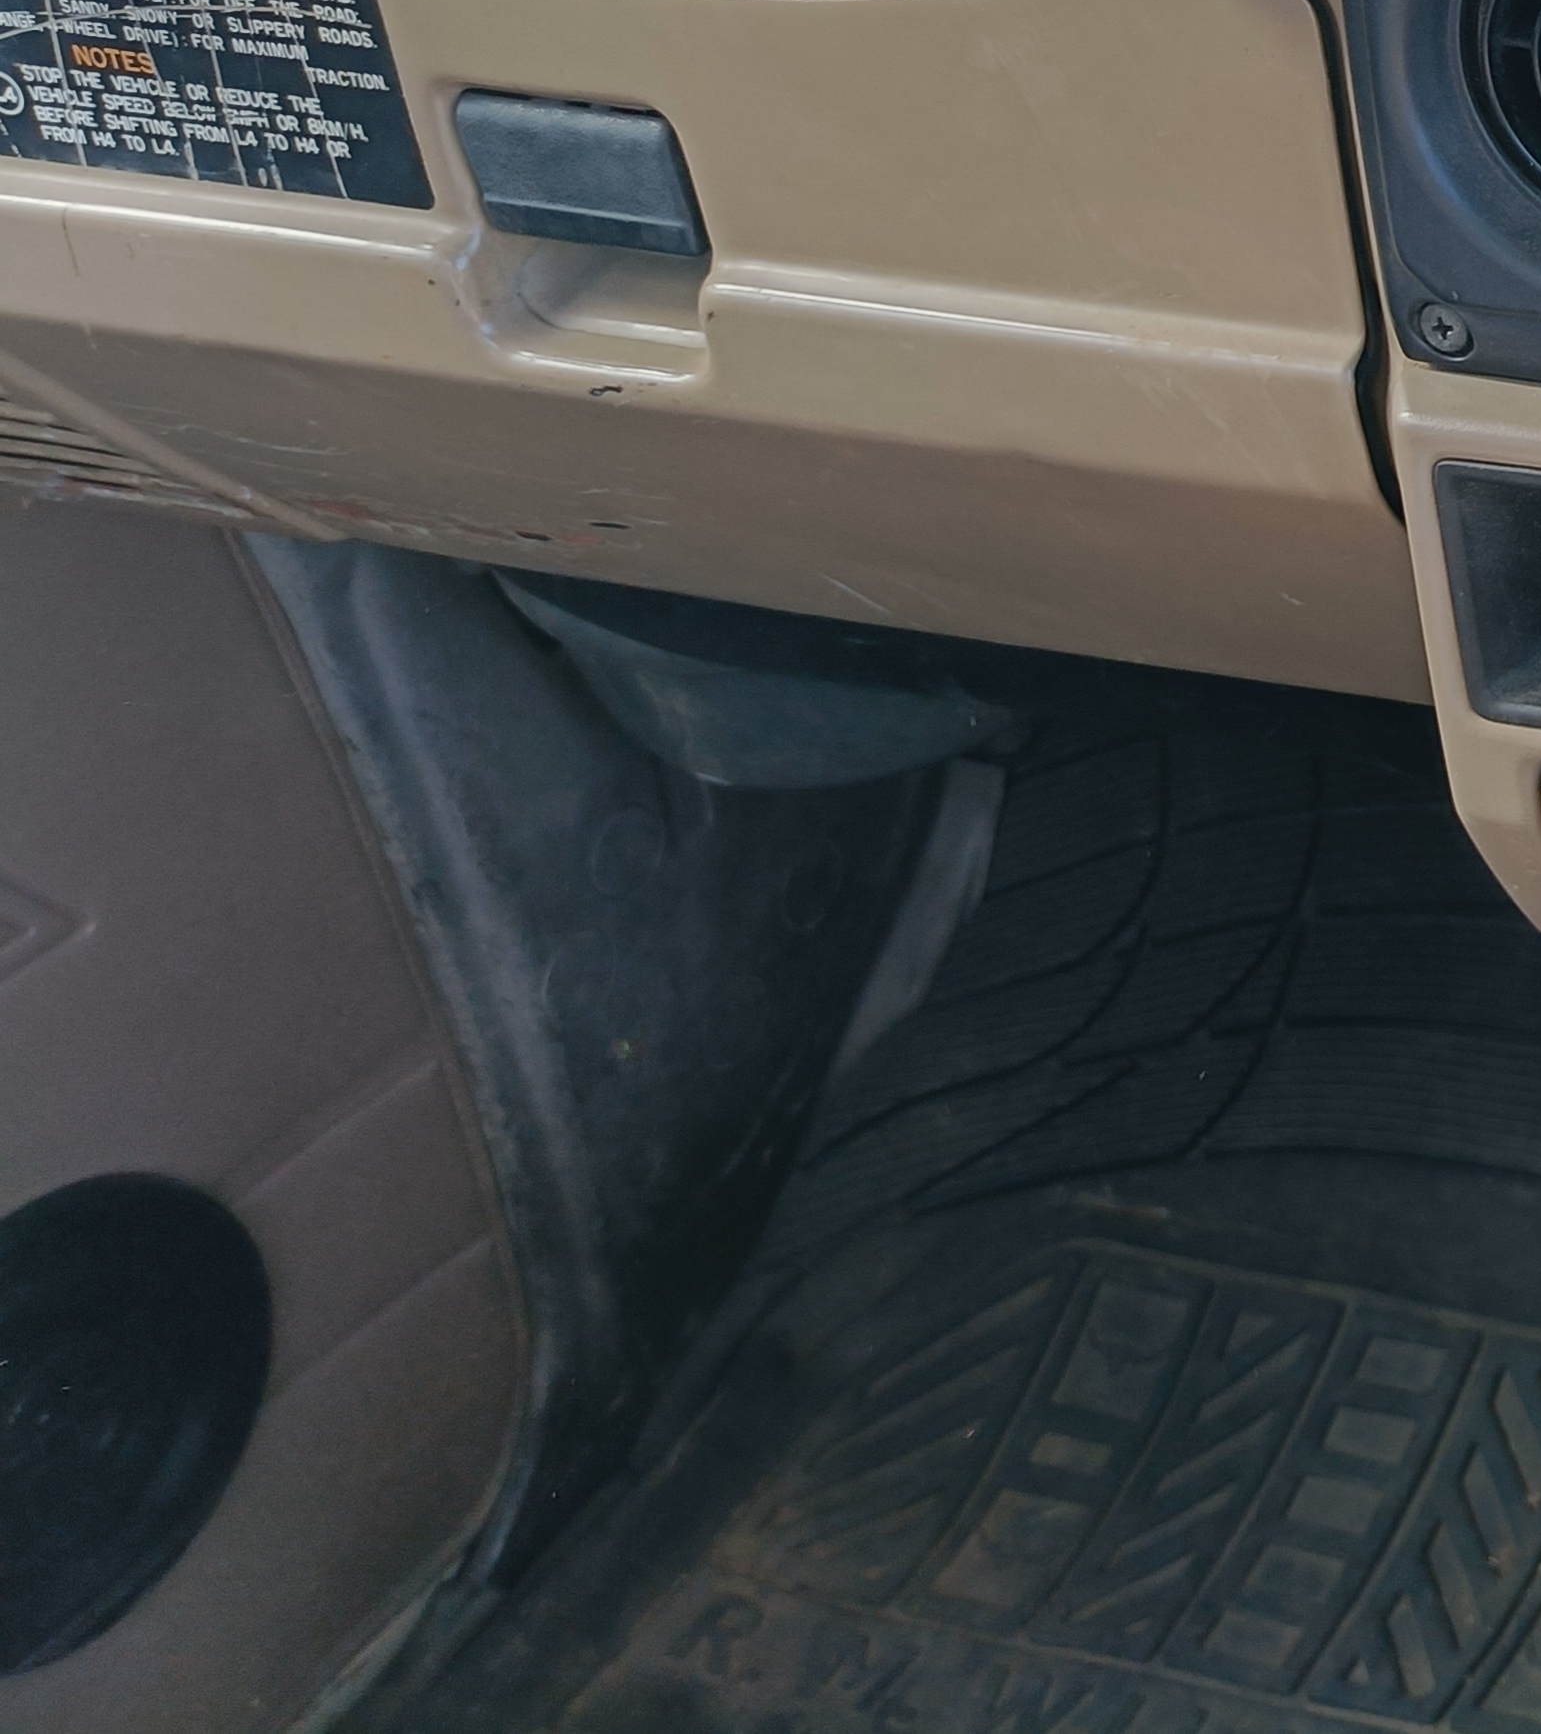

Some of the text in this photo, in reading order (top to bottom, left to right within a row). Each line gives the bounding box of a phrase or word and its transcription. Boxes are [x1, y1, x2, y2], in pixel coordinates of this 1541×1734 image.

[192, 13, 215, 31] OR
[226, 16, 305, 40] SLIPPERY
[71, 44, 155, 75] NOTES
[190, 32, 226, 53] FOR
[231, 38, 309, 62] MAXIMUM
[19, 63, 324, 116] STOP THE VEHICLE OR REDUCE THE
[26, 84, 97, 109] VEHICLE
[102, 92, 156, 116] SPEED
[275, 113, 300, 133] OR
[32, 104, 352, 160] BEFORE SHIFTING FROM L4 TO H4 OR
[40, 124, 88, 146] FROM
[91, 130, 117, 149] H4
[120, 133, 146, 154] TO
